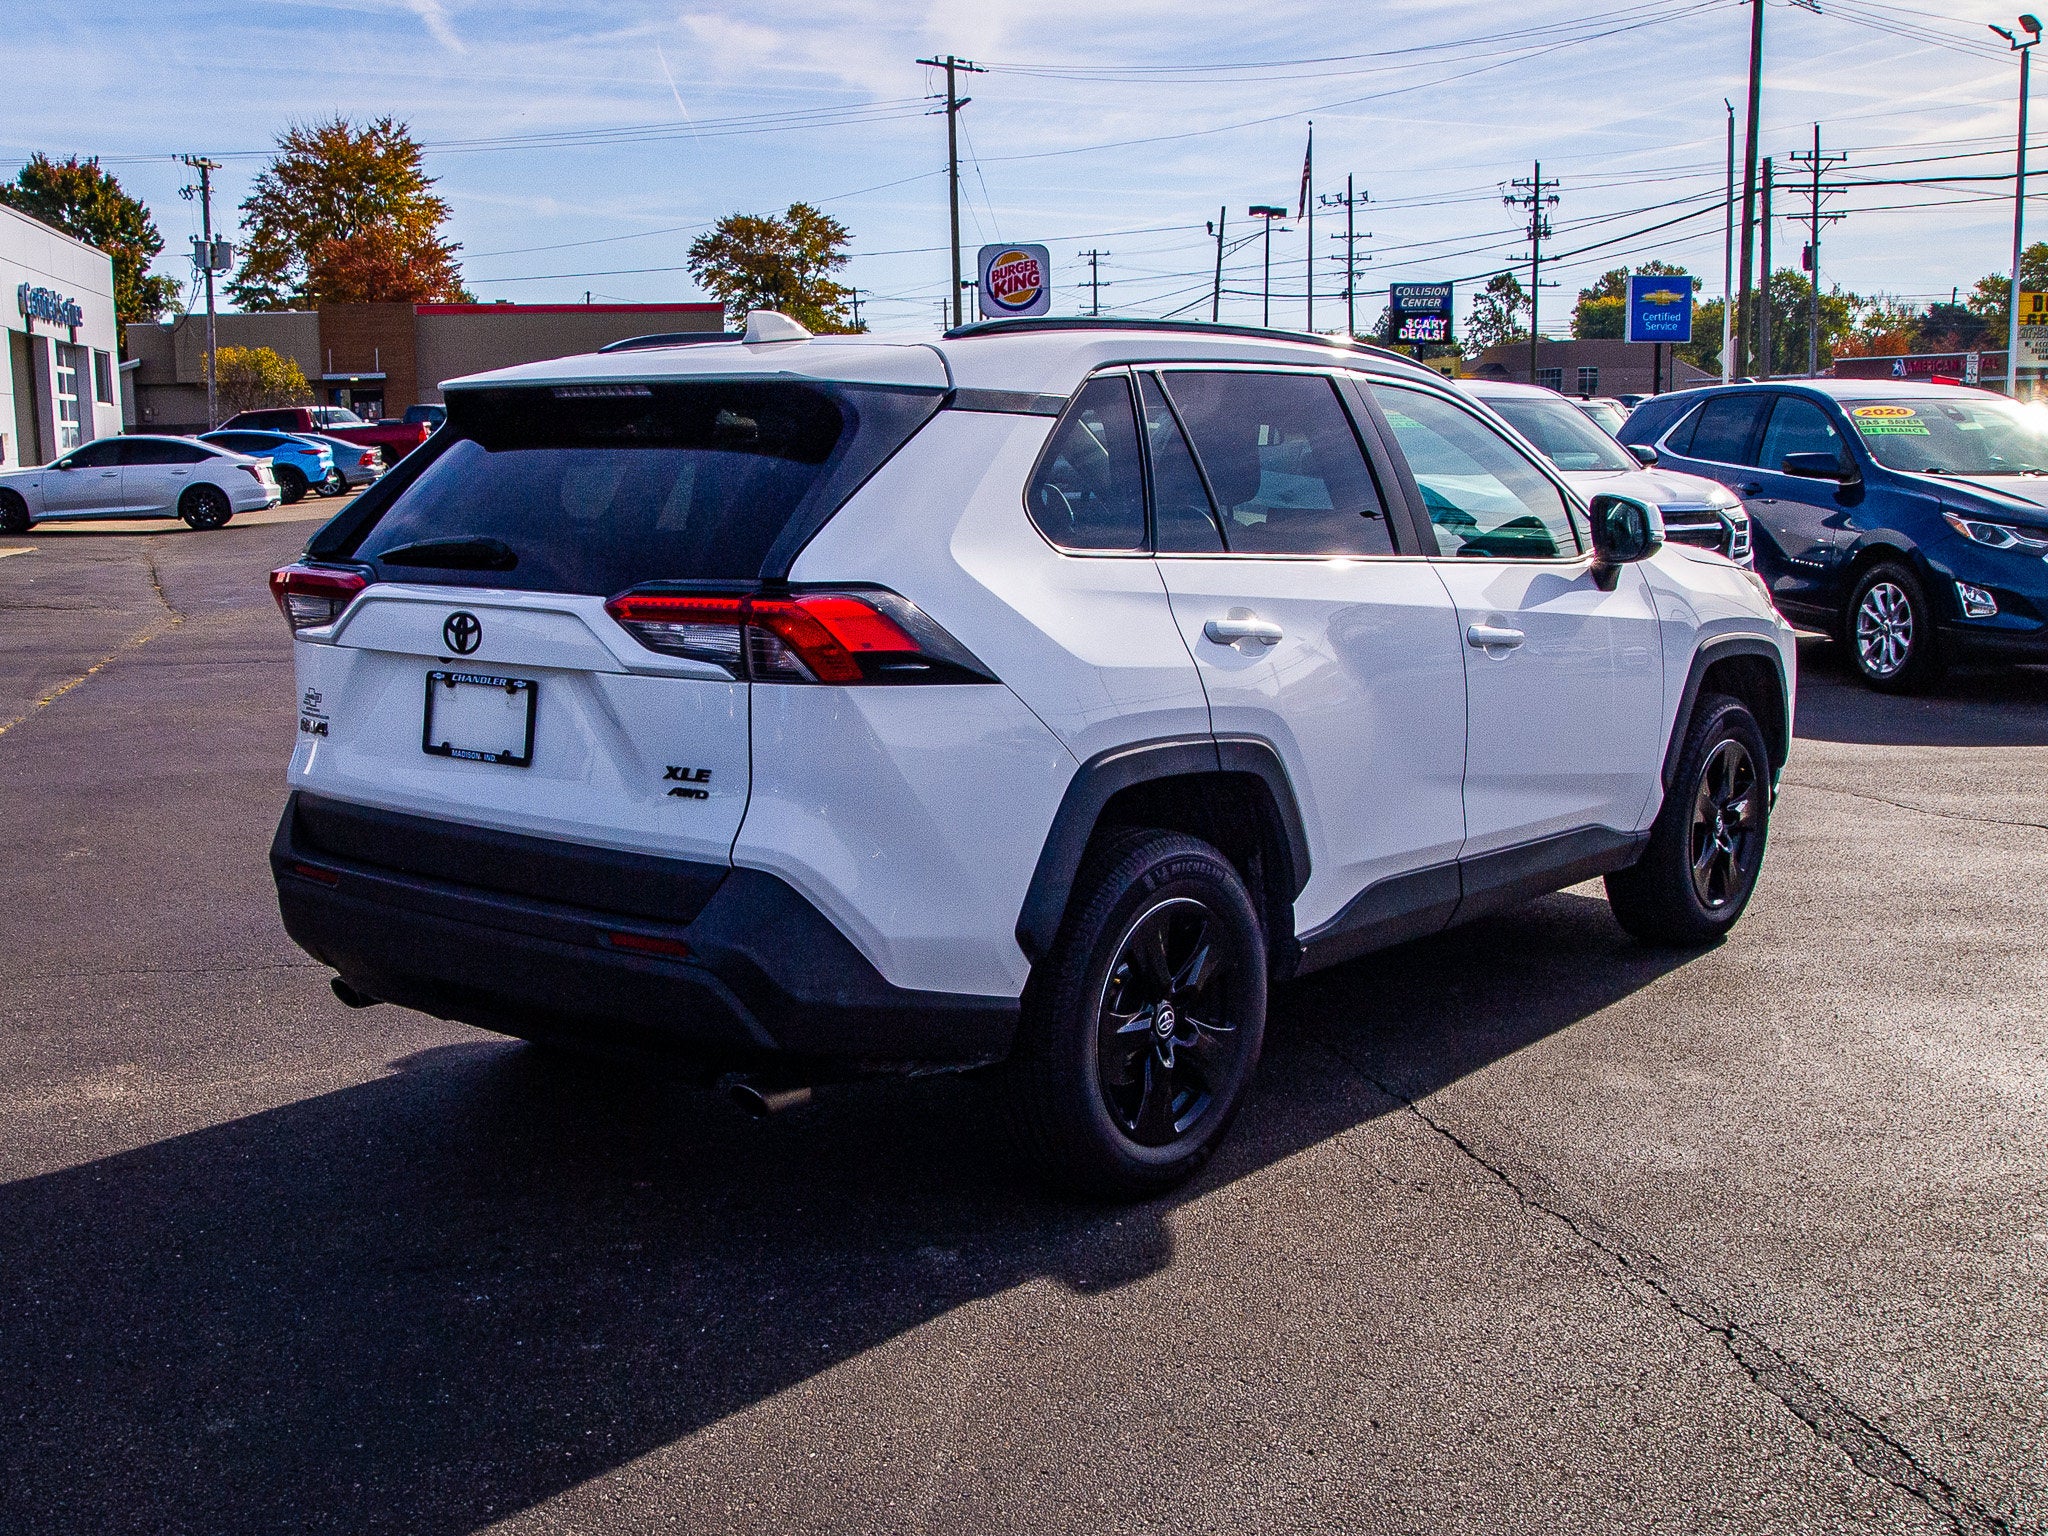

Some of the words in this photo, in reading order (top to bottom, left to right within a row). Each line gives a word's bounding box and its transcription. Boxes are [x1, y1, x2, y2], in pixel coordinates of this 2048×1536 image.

[992, 259, 1039, 283] BURGER
[994, 270, 1040, 299] KING
[1395, 286, 1449, 296] COLLISION
[1401, 297, 1442, 307] CENTER
[2032, 295, 2048, 312] D
[1642, 312, 1681, 321] Certified
[1405, 318, 1448, 330] SCARY
[1645, 321, 1678, 330] Service
[1398, 328, 1446, 341] DEALS!
[1907, 359, 1959, 373] AMERICAN
[1861, 408, 1908, 417] 2020
[451, 673, 507, 686] CHANDLER
[662, 765, 712, 783] XLE
[667, 787, 709, 800] AWD
